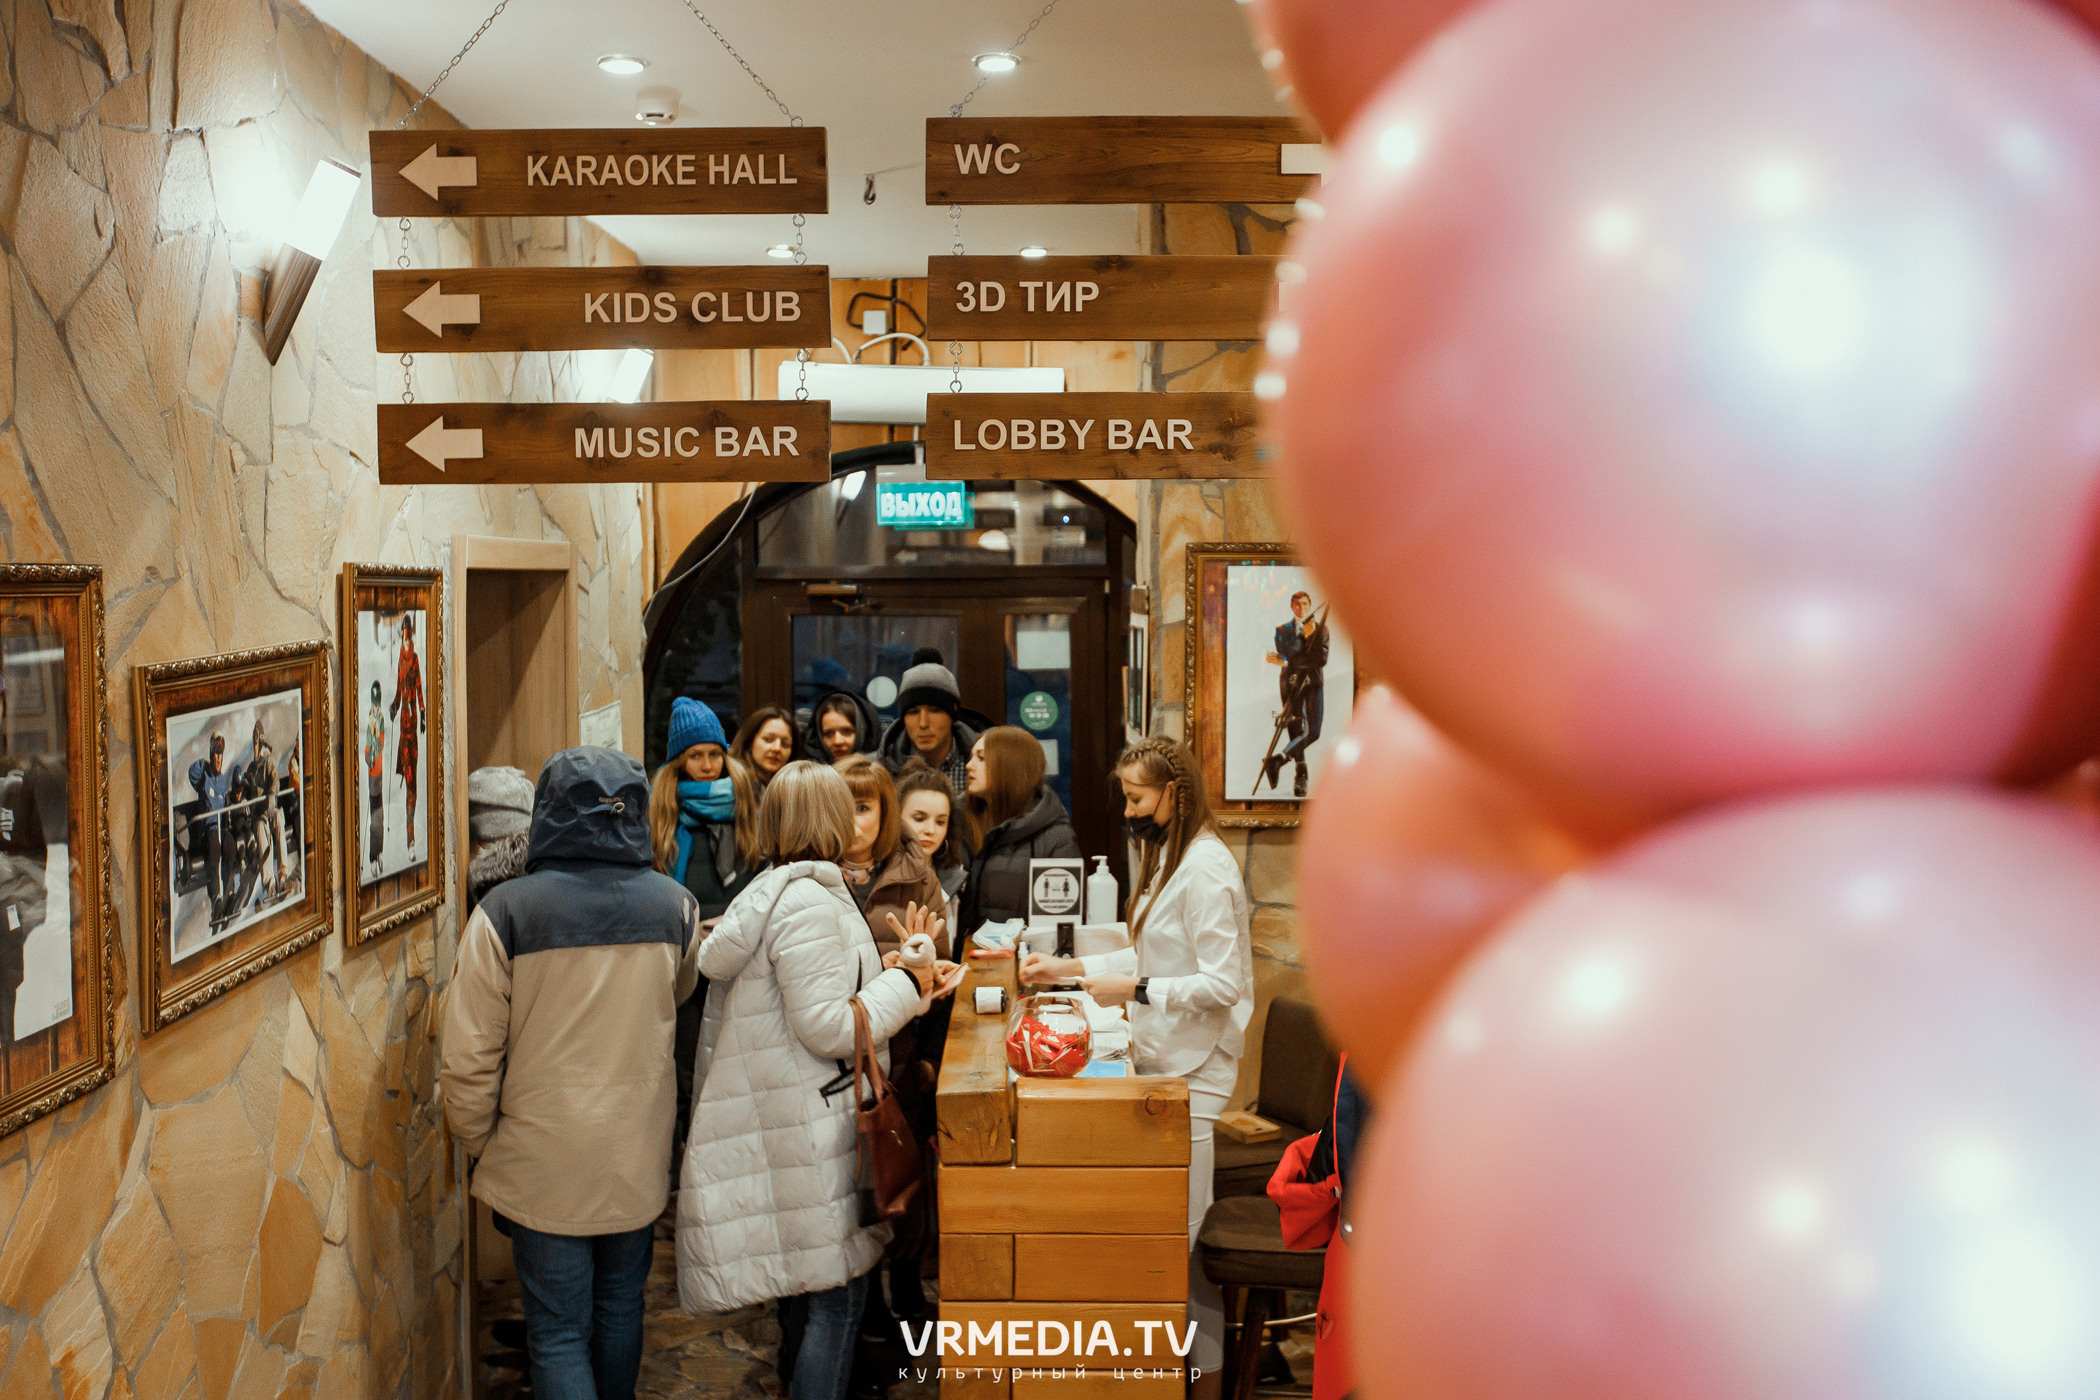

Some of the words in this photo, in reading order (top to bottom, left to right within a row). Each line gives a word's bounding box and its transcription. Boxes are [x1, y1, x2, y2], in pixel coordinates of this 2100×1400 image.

[527, 155, 696, 187] KARAOKE
[708, 154, 798, 185] HALL
[954, 143, 1021, 175] WC
[584, 292, 678, 324] KIDS
[691, 291, 802, 323] CLUB
[956, 281, 1006, 313] 3D
[1019, 280, 1100, 313] ТИР
[575, 426, 700, 459] MUSIC
[715, 425, 800, 457] BAR
[954, 419, 1095, 451] LOBBY
[1107, 419, 1195, 450] BAR
[880, 491, 963, 521] ВЫХОД
